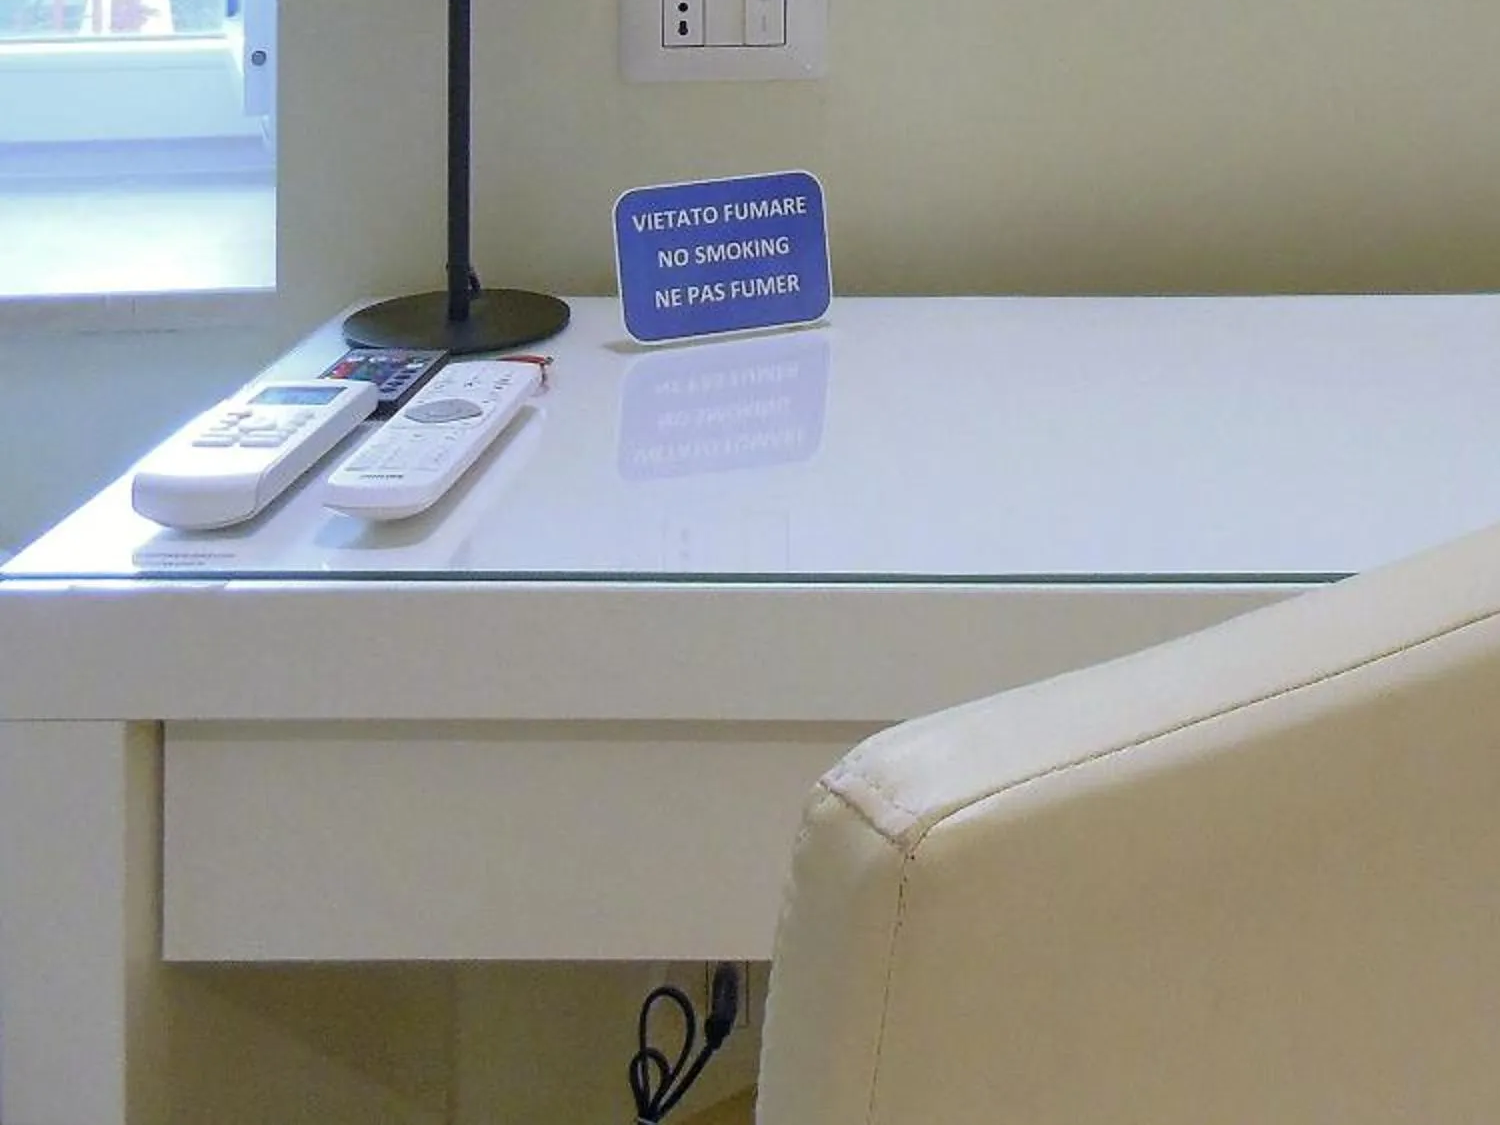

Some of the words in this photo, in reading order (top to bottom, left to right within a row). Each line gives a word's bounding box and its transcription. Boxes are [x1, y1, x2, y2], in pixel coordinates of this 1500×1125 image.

[632, 206, 718, 233] VIETATO
[724, 196, 807, 222] FUMARE
[657, 249, 689, 268] NO
[695, 236, 790, 264] SMOKING
[655, 288, 681, 308] NE
[688, 284, 725, 305] PAS
[731, 274, 800, 298] FUMER
